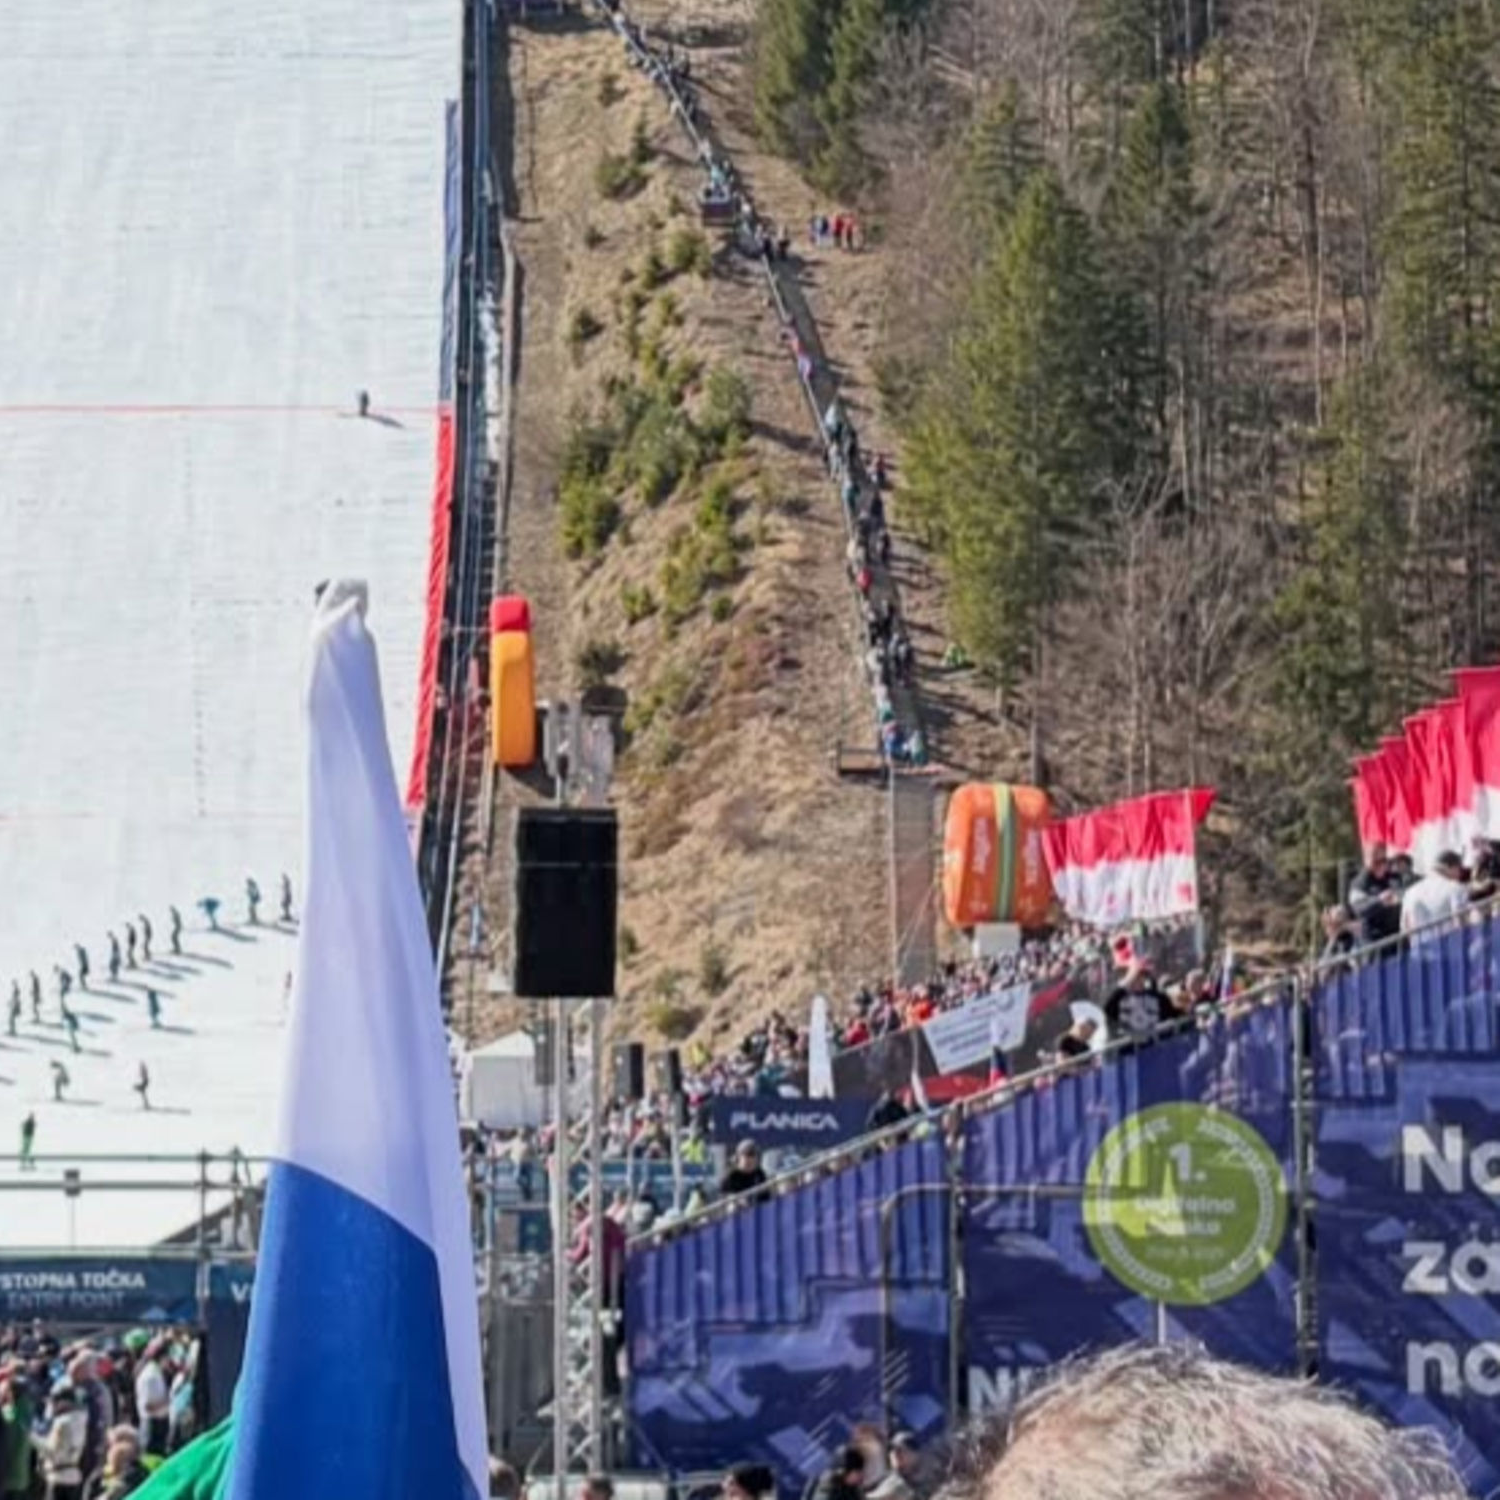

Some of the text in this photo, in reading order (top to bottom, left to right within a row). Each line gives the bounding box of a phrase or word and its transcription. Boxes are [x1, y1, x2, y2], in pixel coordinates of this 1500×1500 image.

[730, 1111, 839, 1131] PLANICA
[80, 1267, 146, 1289] TOČKA
[8, 1291, 126, 1309] ENTRY POINT
